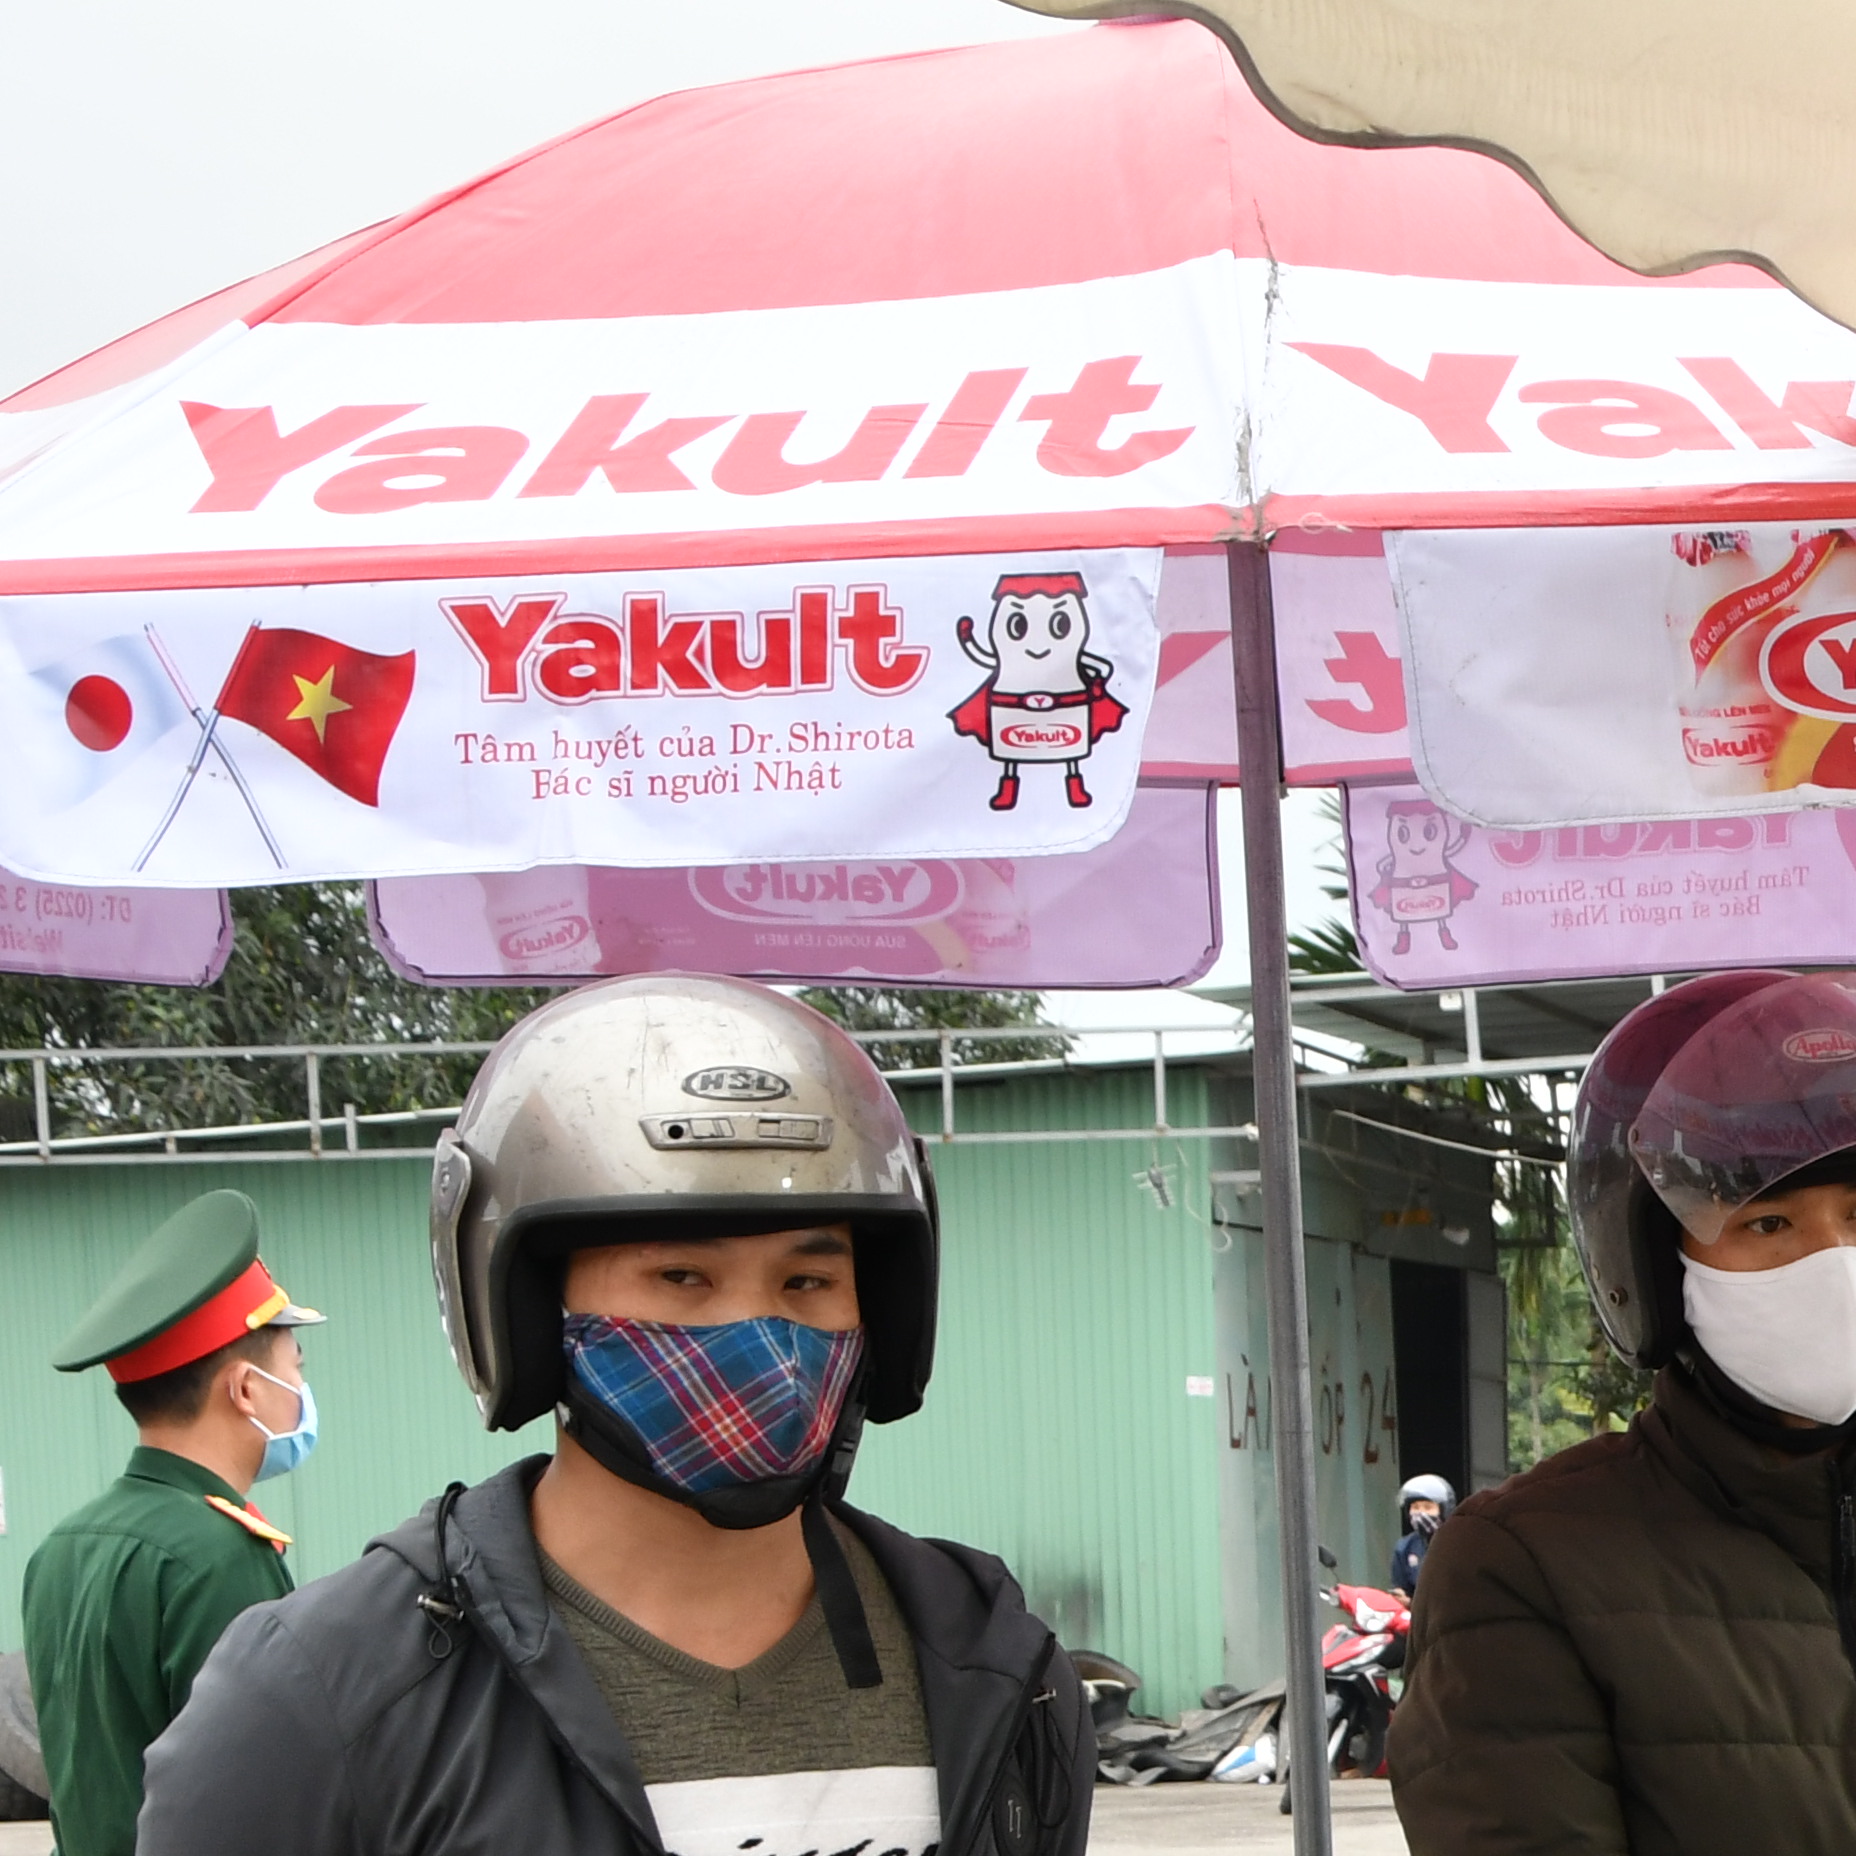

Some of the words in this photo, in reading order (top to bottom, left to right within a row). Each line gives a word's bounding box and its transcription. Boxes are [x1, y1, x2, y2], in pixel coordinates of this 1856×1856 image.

[178, 354, 1198, 516] Yakult
[444, 585, 928, 702] Yakult
[1708, 621, 1726, 643] cho
[454, 731, 537, 765] Tâm
[551, 724, 645, 768] huyết
[658, 724, 717, 759] của
[1010, 727, 1075, 746] Yakult
[530, 766, 592, 800] Bác
[606, 769, 635, 798] sĩ
[646, 763, 741, 804] người
[753, 760, 843, 797] Nhật
[699, 1072, 780, 1093] HSL
[1227, 1352, 1272, 1451] LÀ
